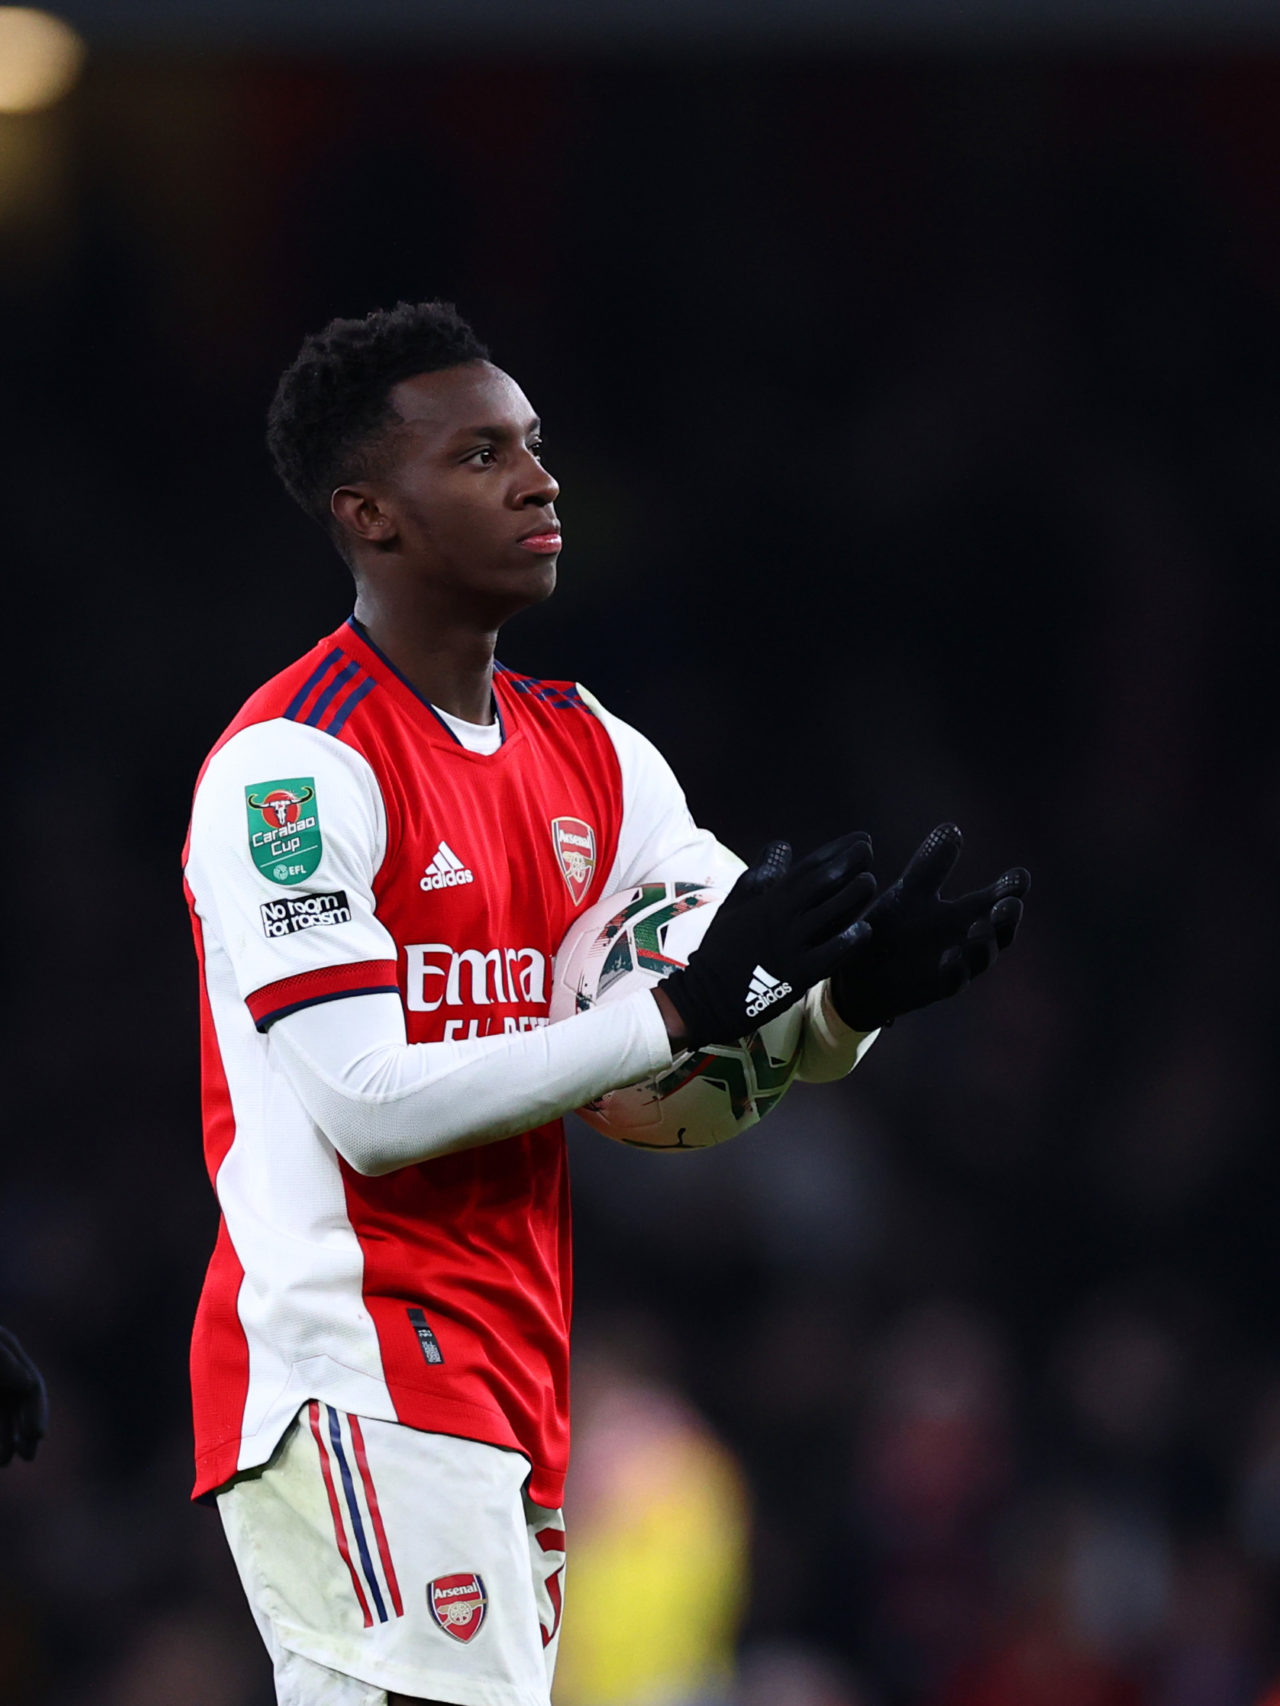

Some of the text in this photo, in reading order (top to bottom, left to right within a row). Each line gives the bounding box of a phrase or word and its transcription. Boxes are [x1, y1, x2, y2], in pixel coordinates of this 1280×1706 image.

[252, 816, 315, 848] Carabao
[271, 837, 300, 856] Cup
[288, 864, 307, 876] EFL
[420, 869, 474, 891] adidas
[261, 896, 339, 921] No room
[291, 907, 351, 931] racism
[746, 982, 792, 1017] adidas
[433, 1581, 478, 1600] Arsenal
